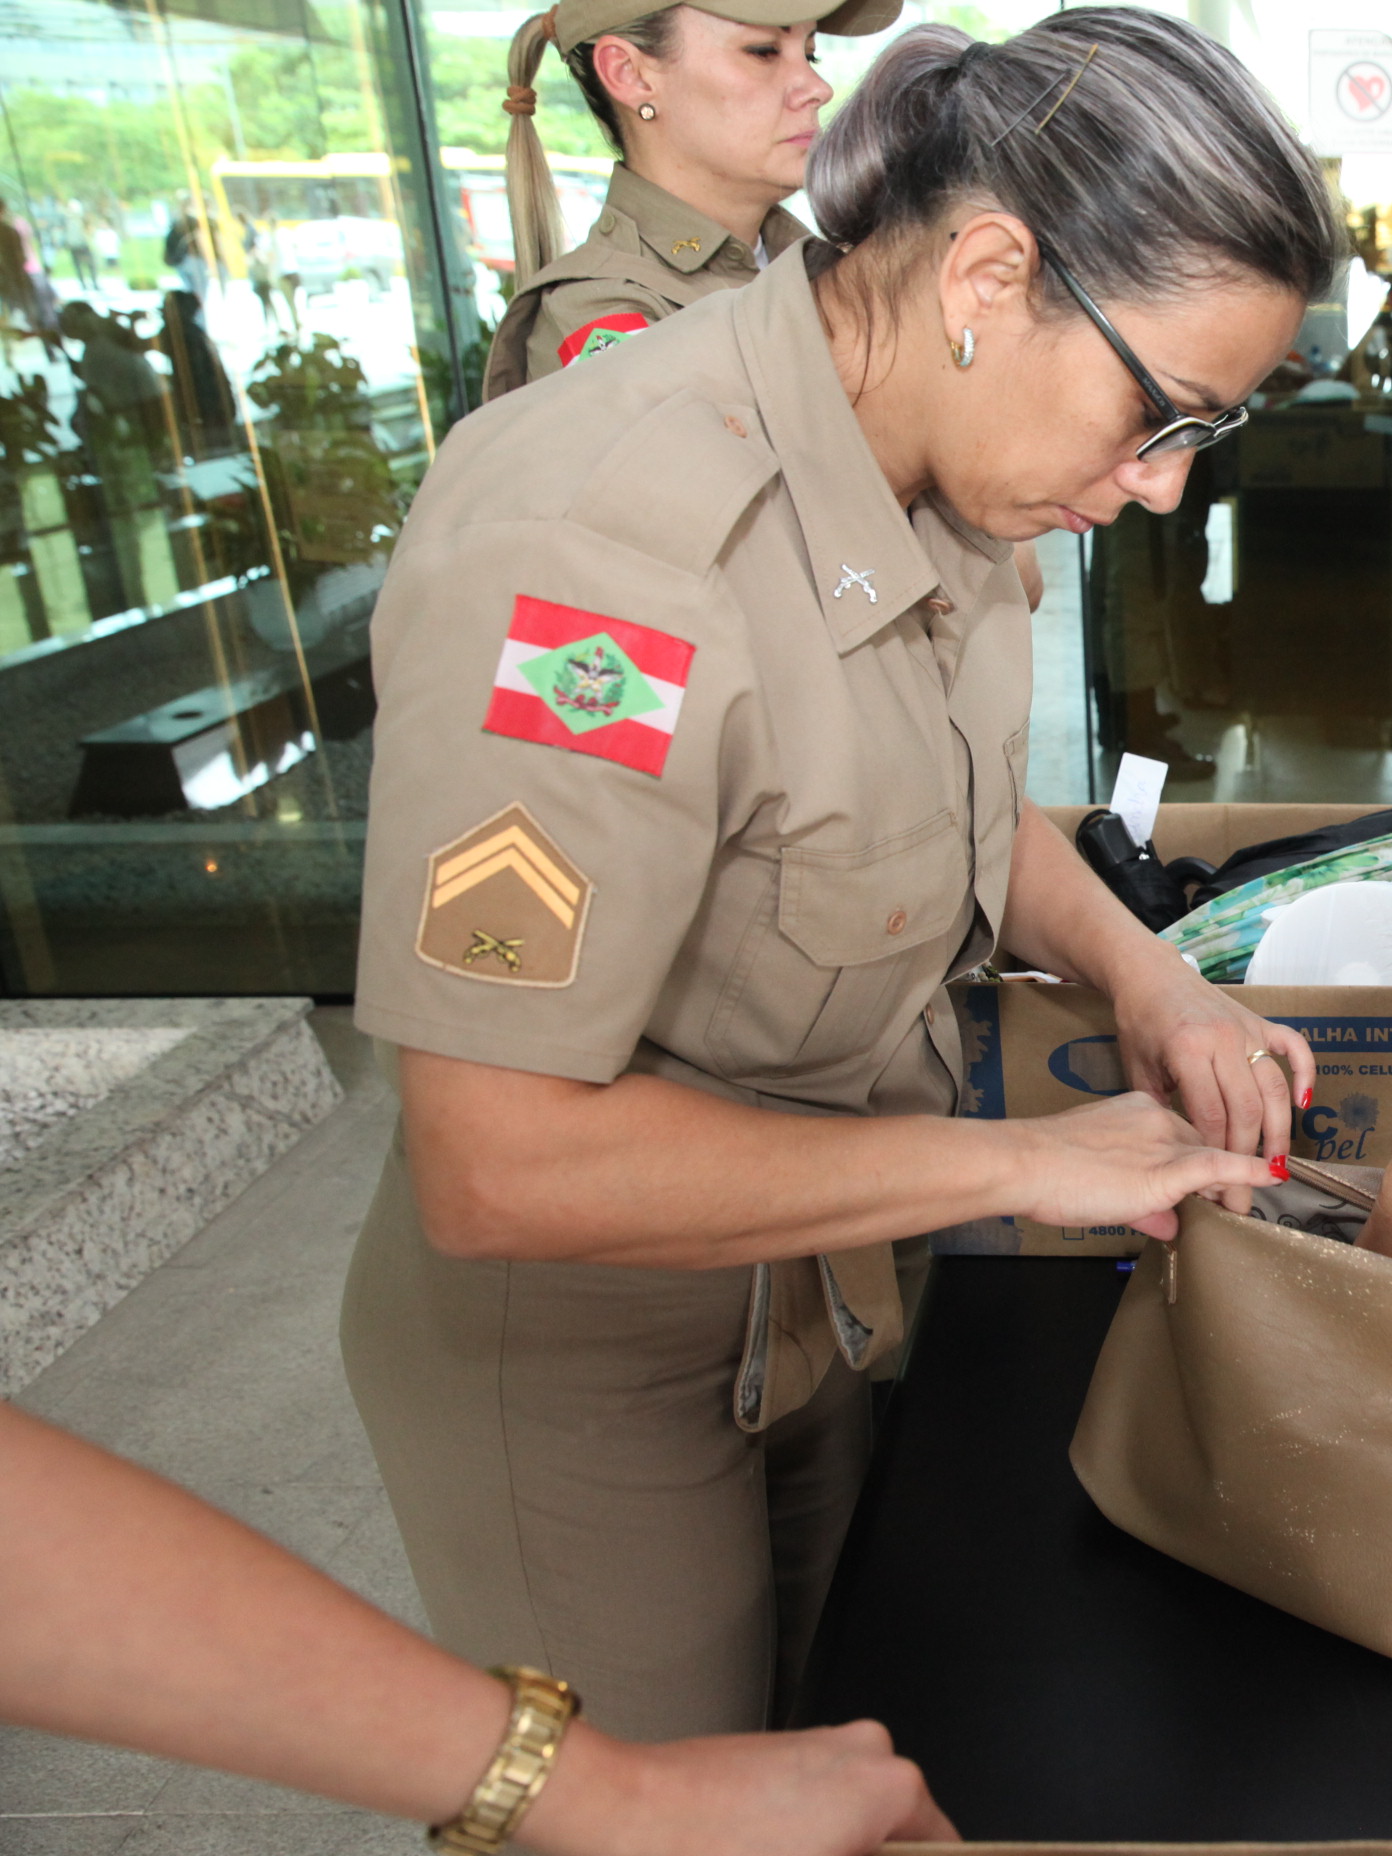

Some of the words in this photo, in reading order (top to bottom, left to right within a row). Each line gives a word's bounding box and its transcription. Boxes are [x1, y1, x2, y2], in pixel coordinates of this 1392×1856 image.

[1299, 1027, 1358, 1043] ALHA
[1314, 1127, 1375, 1161] pel
[1088, 1225, 1126, 1236] 4800
